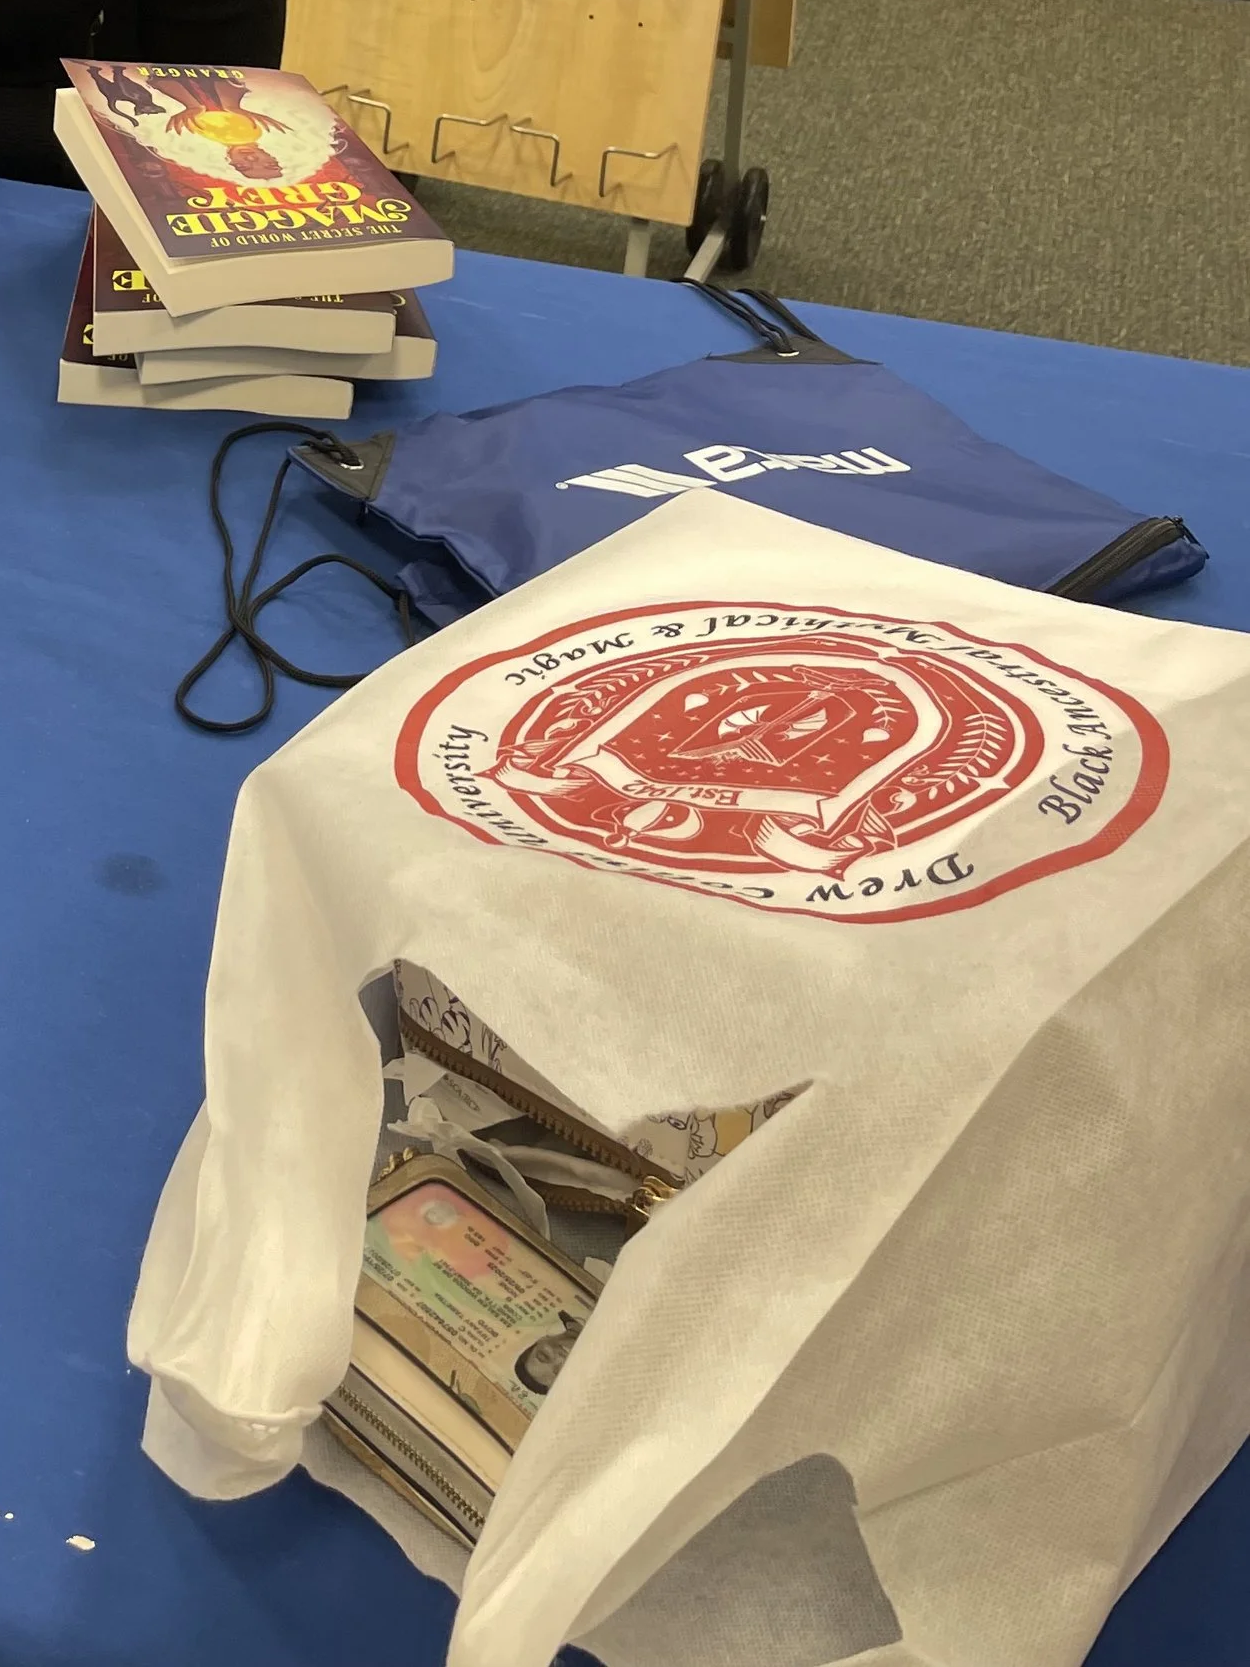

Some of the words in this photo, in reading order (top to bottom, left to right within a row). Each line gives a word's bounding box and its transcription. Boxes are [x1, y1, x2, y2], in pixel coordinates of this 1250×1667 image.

[137, 66, 244, 79] GRANGER
[187, 183, 361, 209] GREY
[166, 199, 412, 236] MAGGIE
[303, 227, 363, 241] SECRET
[367, 225, 402, 235] THE
[211, 236, 229, 247] OF
[239, 231, 298, 246] WORLD
[684, 444, 913, 483] marta
[651, 622, 685, 639] &
[703, 612, 946, 645] Mythical
[503, 632, 635, 686] Magic
[928, 645, 1113, 742] Ancestral
[444, 724, 548, 848] University
[1038, 734, 1113, 826] Black
[806, 850, 974, 904] Drew
